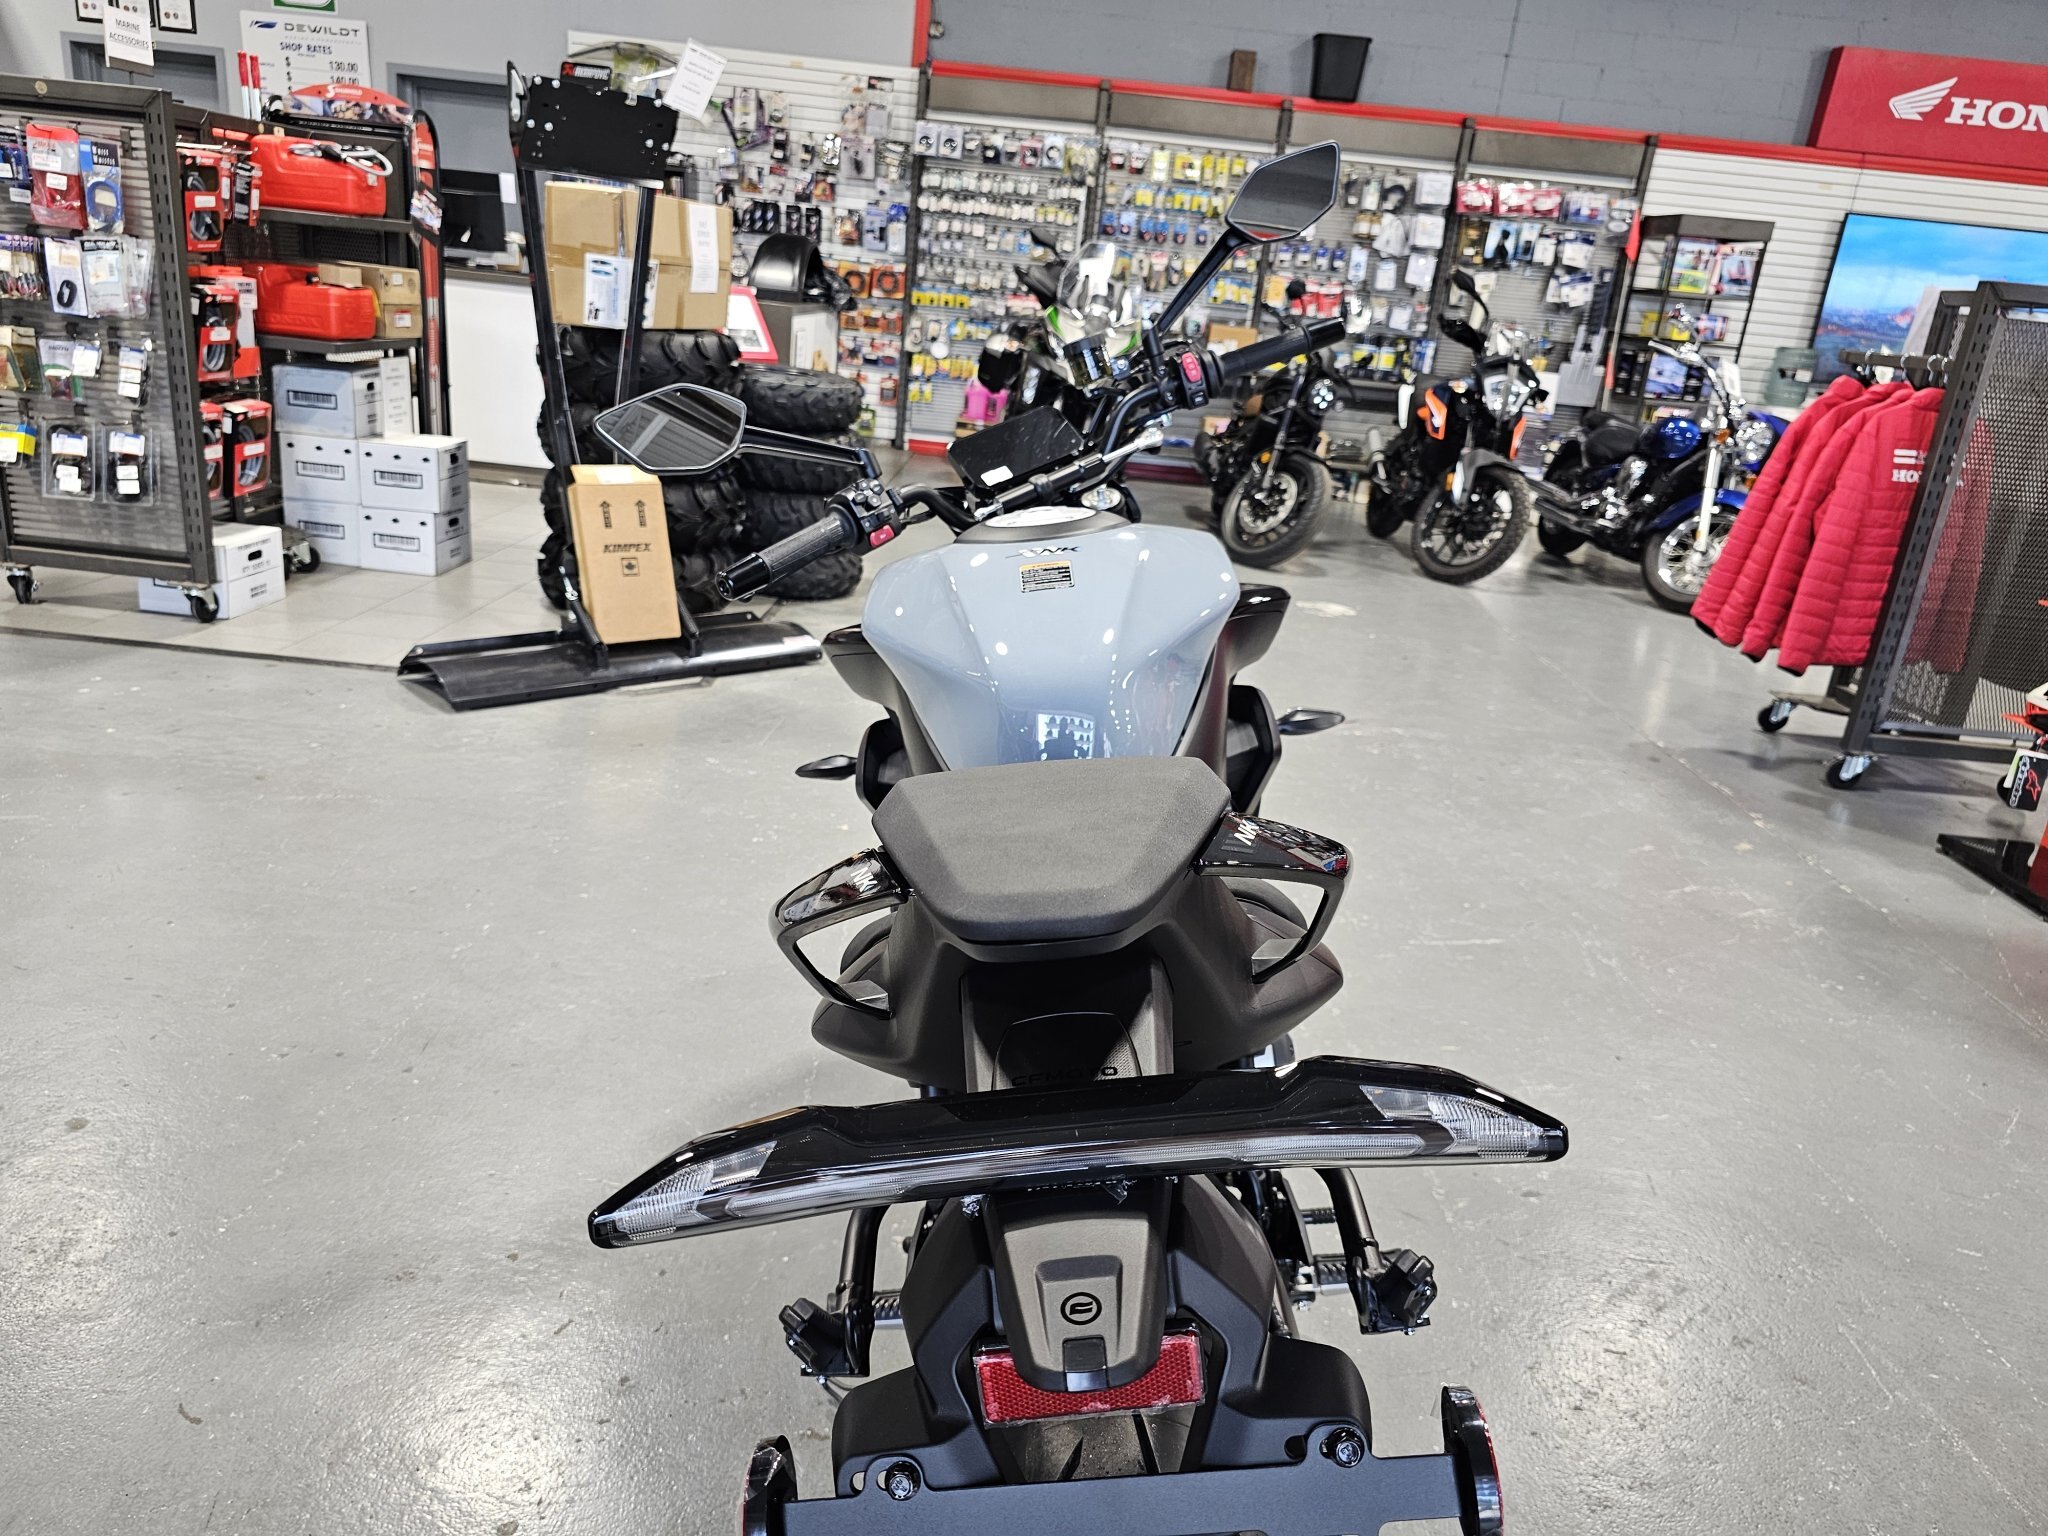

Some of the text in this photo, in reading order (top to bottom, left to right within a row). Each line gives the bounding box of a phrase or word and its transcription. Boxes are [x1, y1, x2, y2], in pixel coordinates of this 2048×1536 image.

[115, 18, 141, 31] MARINE
[284, 22, 360, 38] DEWILDT
[109, 32, 150, 49] ACCESSORIES
[280, 42, 333, 55] SHOP RATES
[329, 61, 358, 73] 130.00
[603, 543, 652, 553] KIMPEX
[1233, 818, 1260, 846] NK
